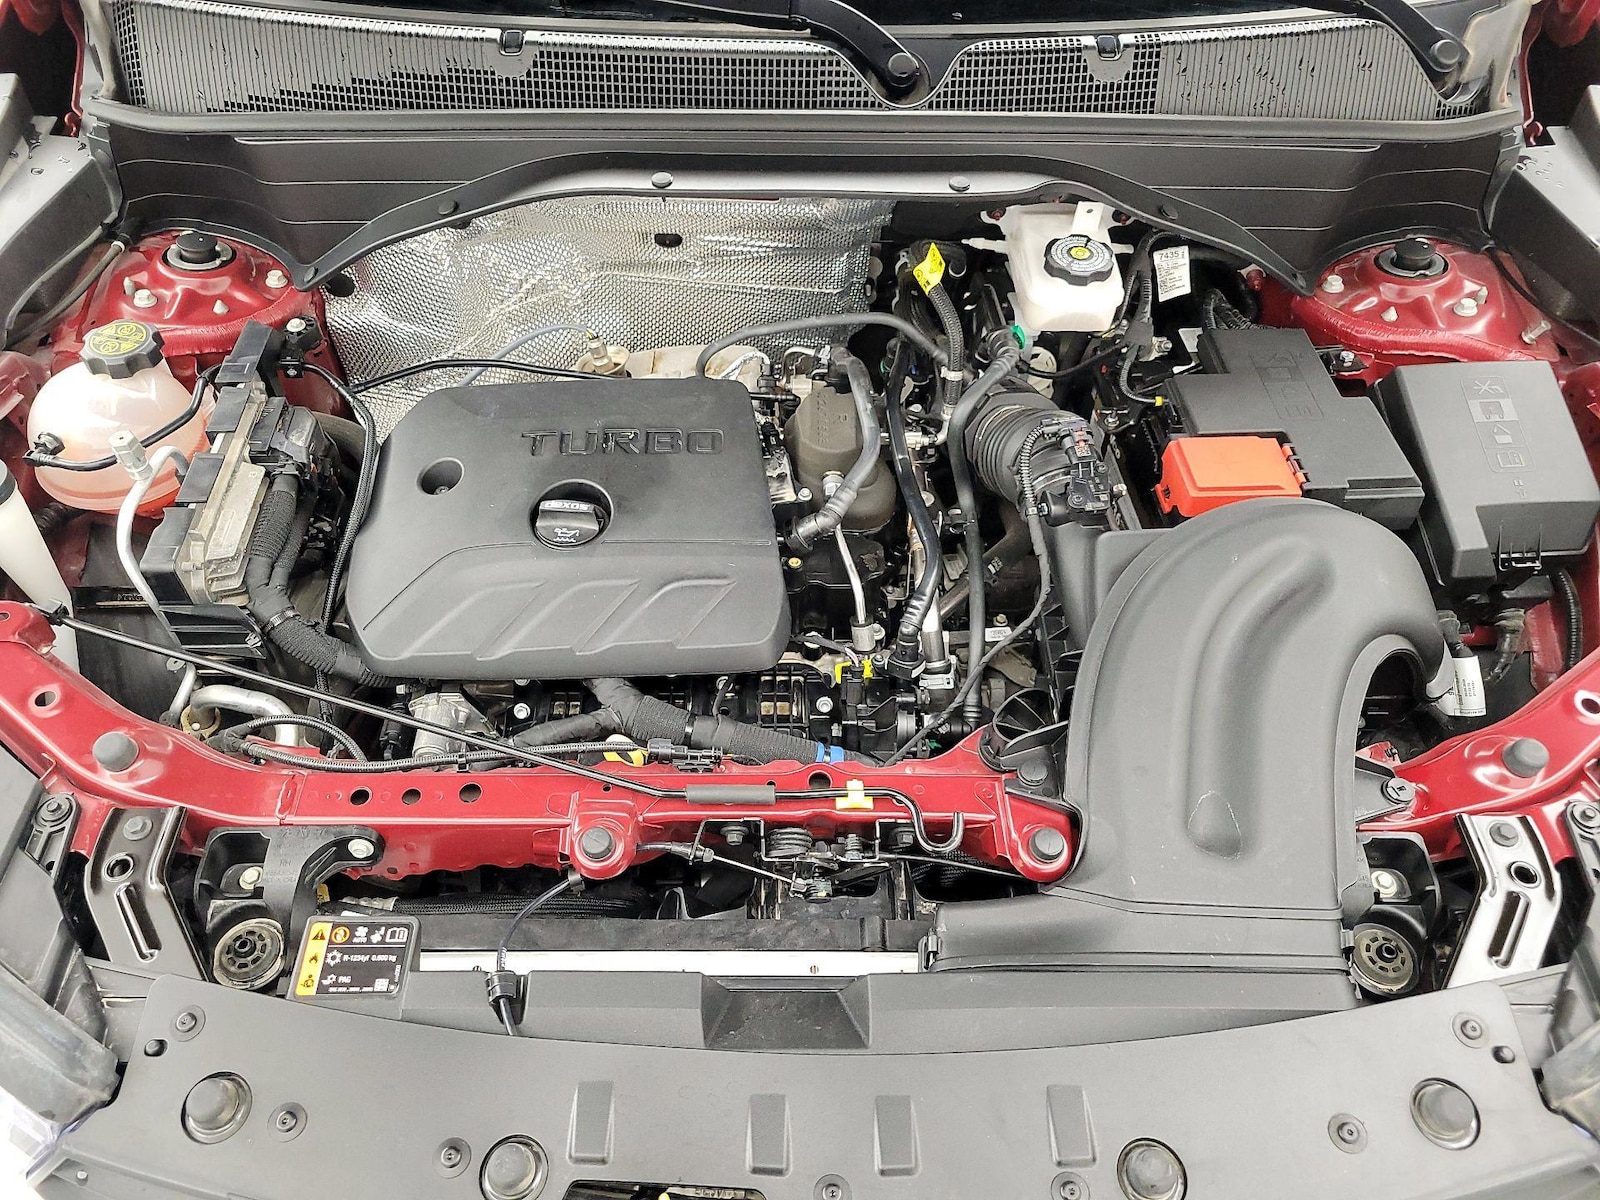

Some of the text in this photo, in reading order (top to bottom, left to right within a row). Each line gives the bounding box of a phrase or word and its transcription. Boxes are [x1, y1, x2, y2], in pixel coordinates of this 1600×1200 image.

[1158, 250, 1180, 260] 7435
[521, 427, 725, 456] TURBO
[544, 500, 591, 511] dexos
[337, 975, 352, 984] PAG
